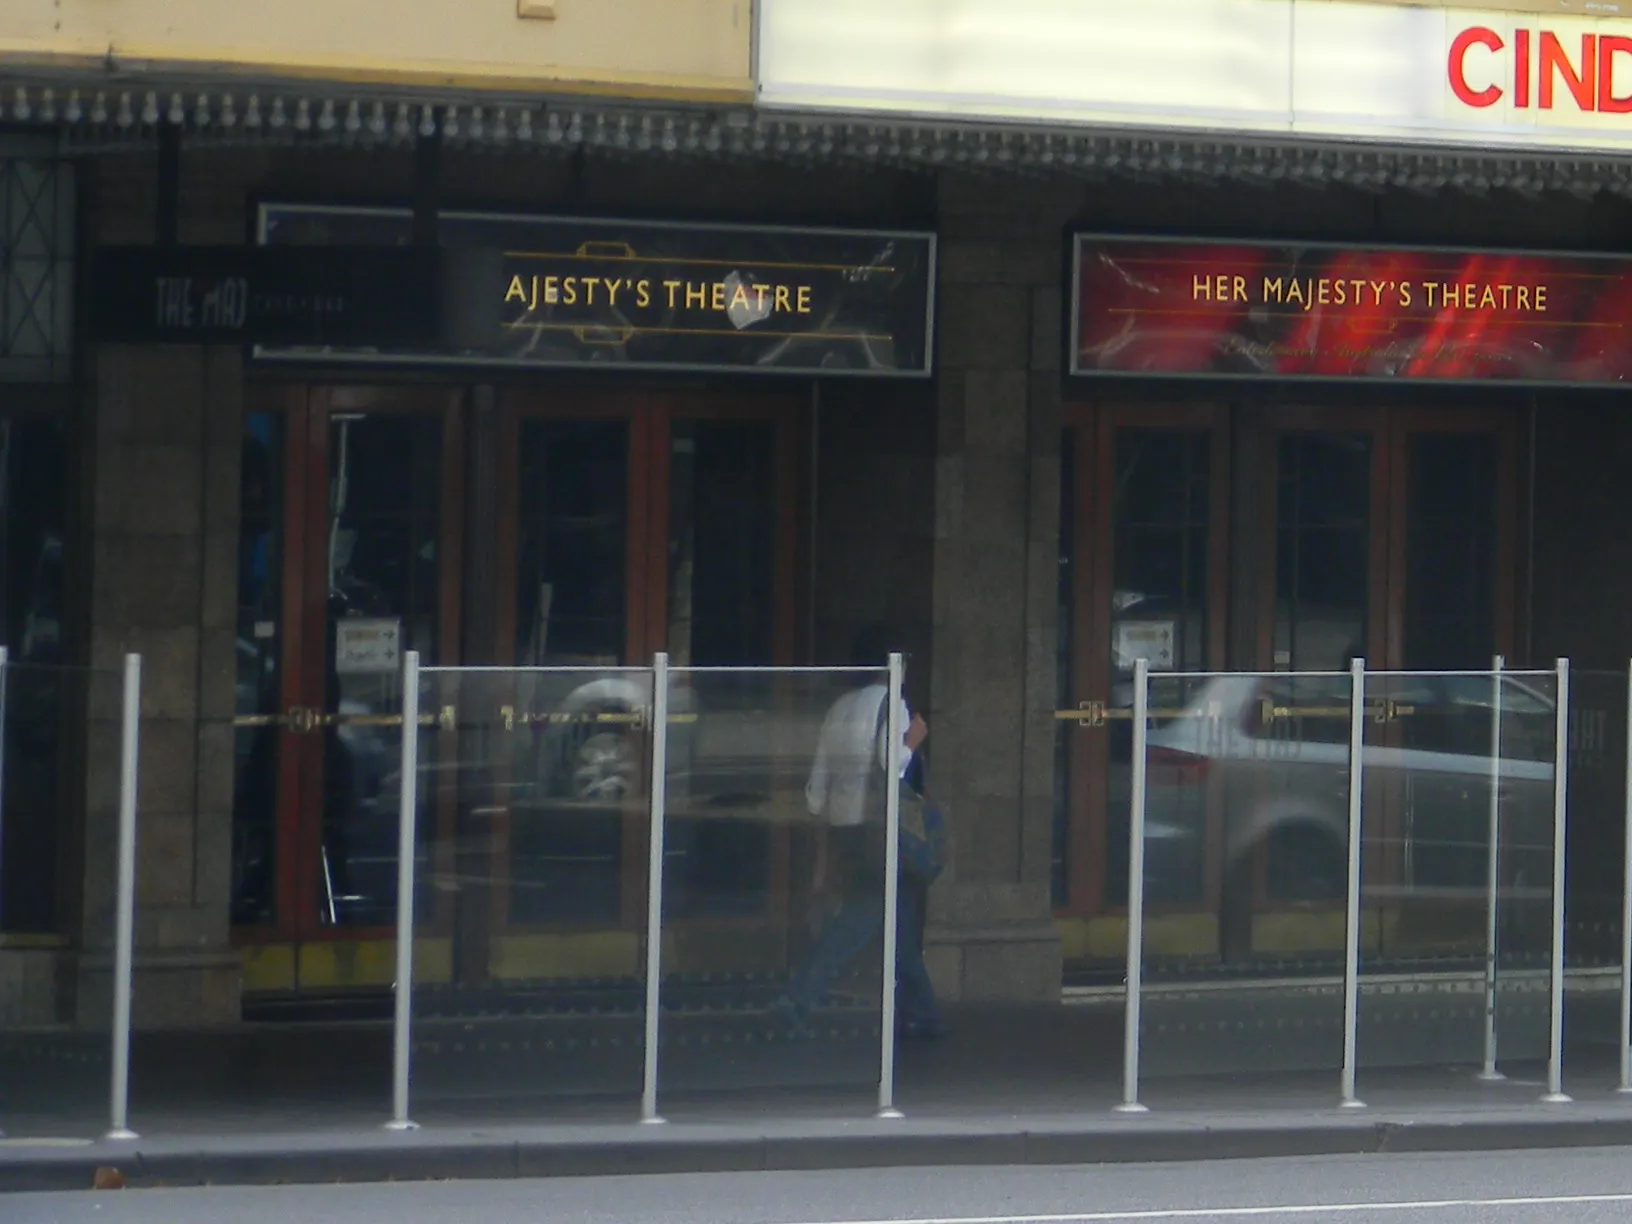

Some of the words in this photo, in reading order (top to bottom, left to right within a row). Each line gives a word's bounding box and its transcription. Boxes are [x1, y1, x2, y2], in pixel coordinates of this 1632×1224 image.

[663, 280, 812, 313] THEATRE
[1193, 275, 1248, 303] HER
[1263, 277, 1412, 311] MAJESTY'S
[1424, 282, 1548, 312] THEATRE
